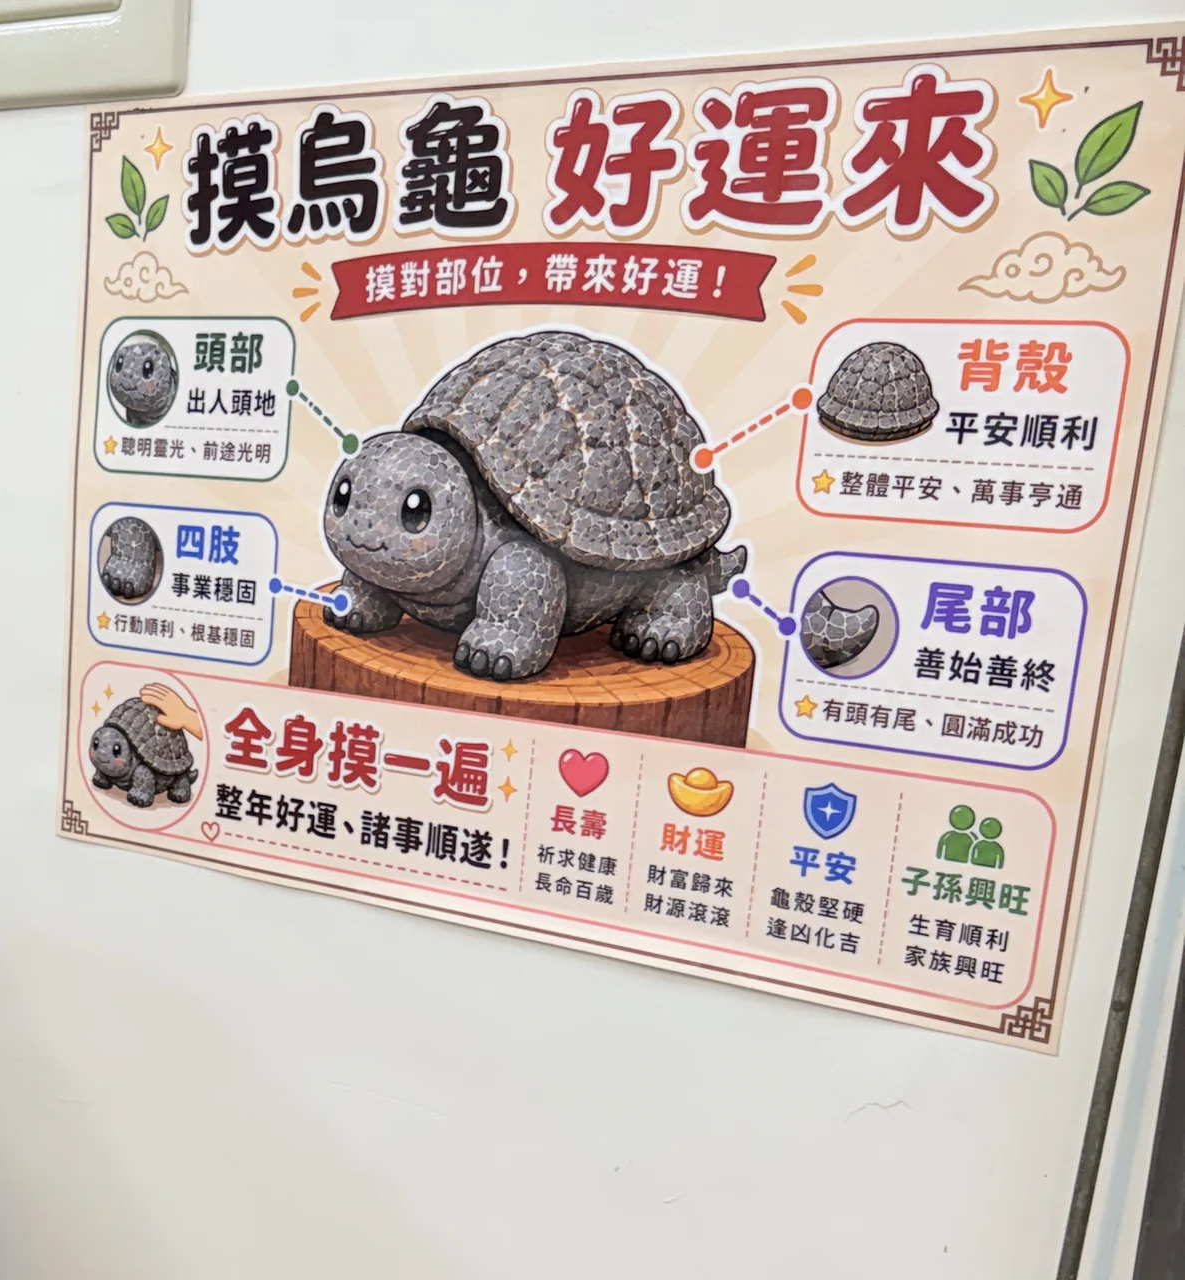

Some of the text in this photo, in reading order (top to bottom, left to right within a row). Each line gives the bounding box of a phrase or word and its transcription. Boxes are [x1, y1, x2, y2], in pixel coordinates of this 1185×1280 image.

[550, 74, 984, 226] 好運來
[188, 102, 507, 245] 摸烏龜
[365, 253, 727, 303] 摸對部位，帶來好運！
[194, 331, 263, 374] 頭部
[958, 339, 1072, 394] 背殼
[187, 388, 276, 417] 出人頭地
[121, 437, 271, 464] 聰明靈光、前途光明
[945, 411, 1098, 451] 平安順利
[839, 471, 1084, 510] 整體平安、萬事亨通
[176, 524, 240, 566] 四肢
[171, 572, 257, 605] 事業穩固
[920, 582, 1035, 639] 尾部
[114, 613, 255, 649] 行動順利、根基穩固
[914, 646, 1056, 693] 善始善終
[822, 698, 1044, 749] 有頭有尾、圓滿成功
[224, 707, 489, 806] 全身摸一遍
[215, 783, 511, 869] 整年好運、諸事順遂！
[550, 804, 607, 840] 長壽
[537, 843, 618, 876] 祈求健康
[660, 823, 726, 862] 財運
[646, 864, 734, 898] 財富歸來
[789, 845, 857, 885] 平安
[535, 872, 614, 905] 長命百歲
[770, 887, 865, 925] 龜殼堅硬
[901, 866, 1031, 916] 子孫興旺
[644, 893, 730, 928] 財源滾滾
[766, 916, 861, 954] 逢凶化吉
[908, 914, 1009, 953] 生育順利
[904, 945, 1005, 984] 家族興旺
